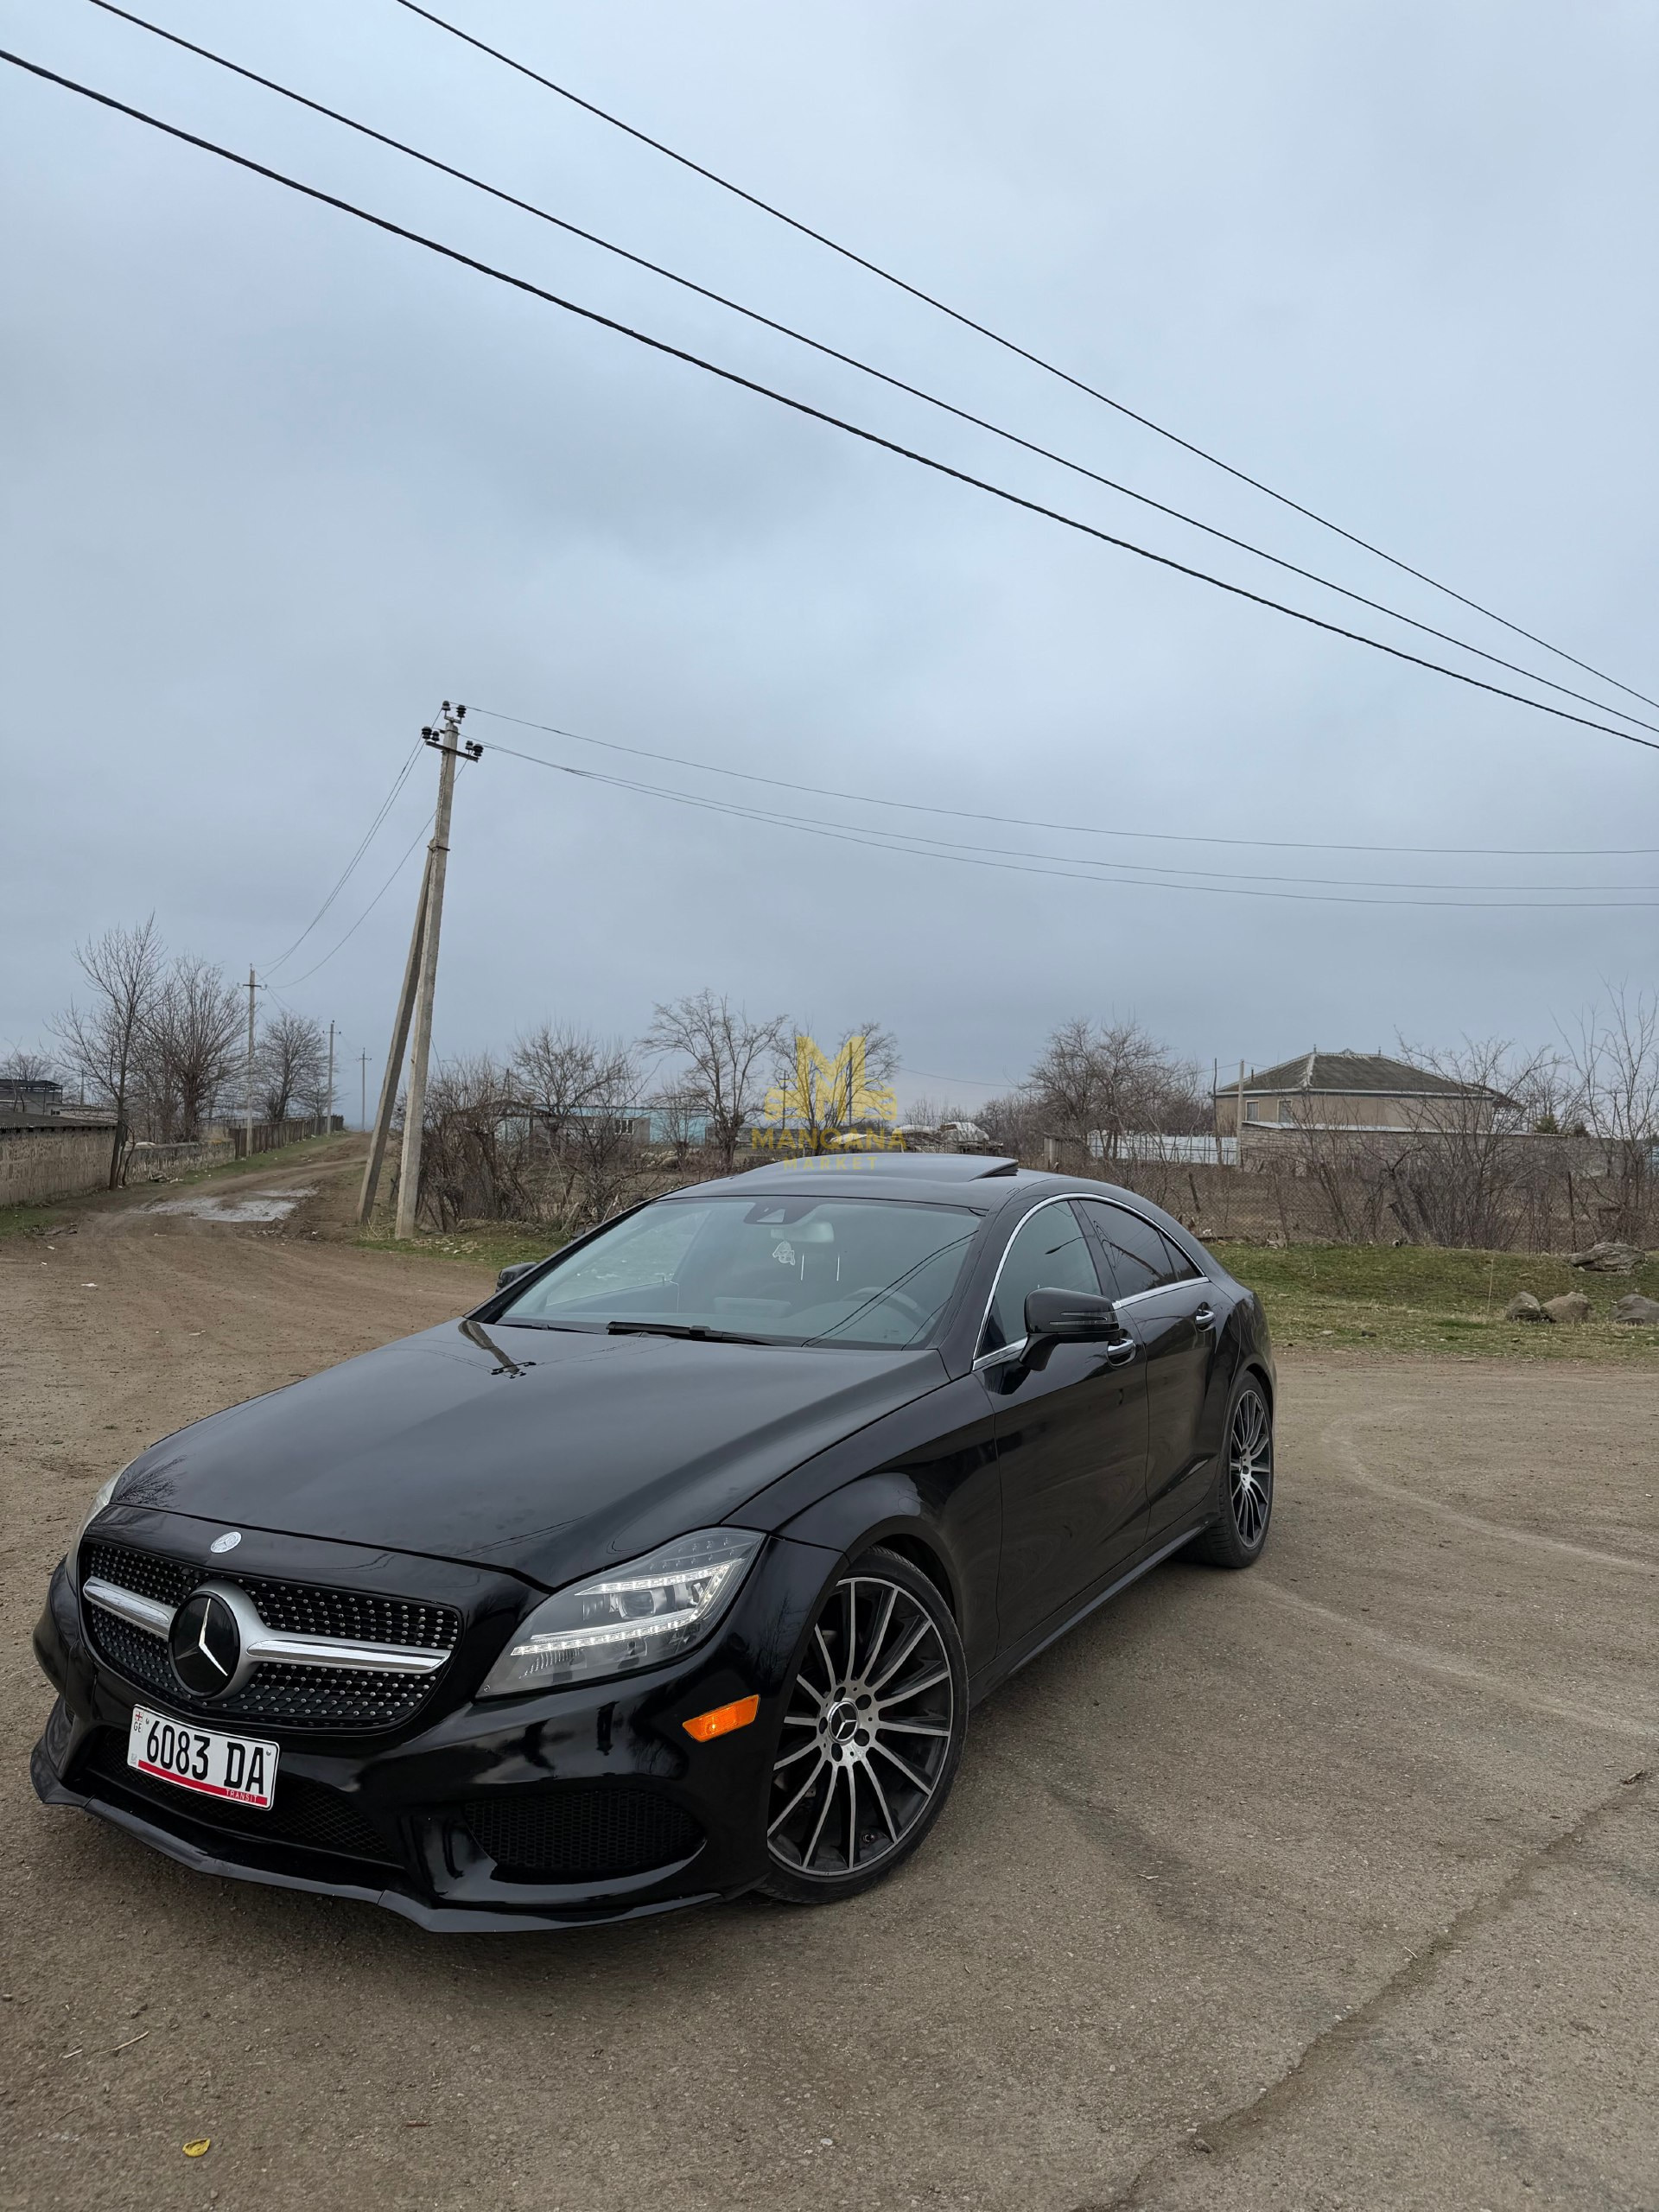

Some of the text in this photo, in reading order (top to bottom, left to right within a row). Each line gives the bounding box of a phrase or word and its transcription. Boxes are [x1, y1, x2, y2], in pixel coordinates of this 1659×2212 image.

[133, 1720, 142, 1733] GE
[147, 1720, 264, 1795] 6083 DA
[226, 1789, 257, 1802] TRANSIT
